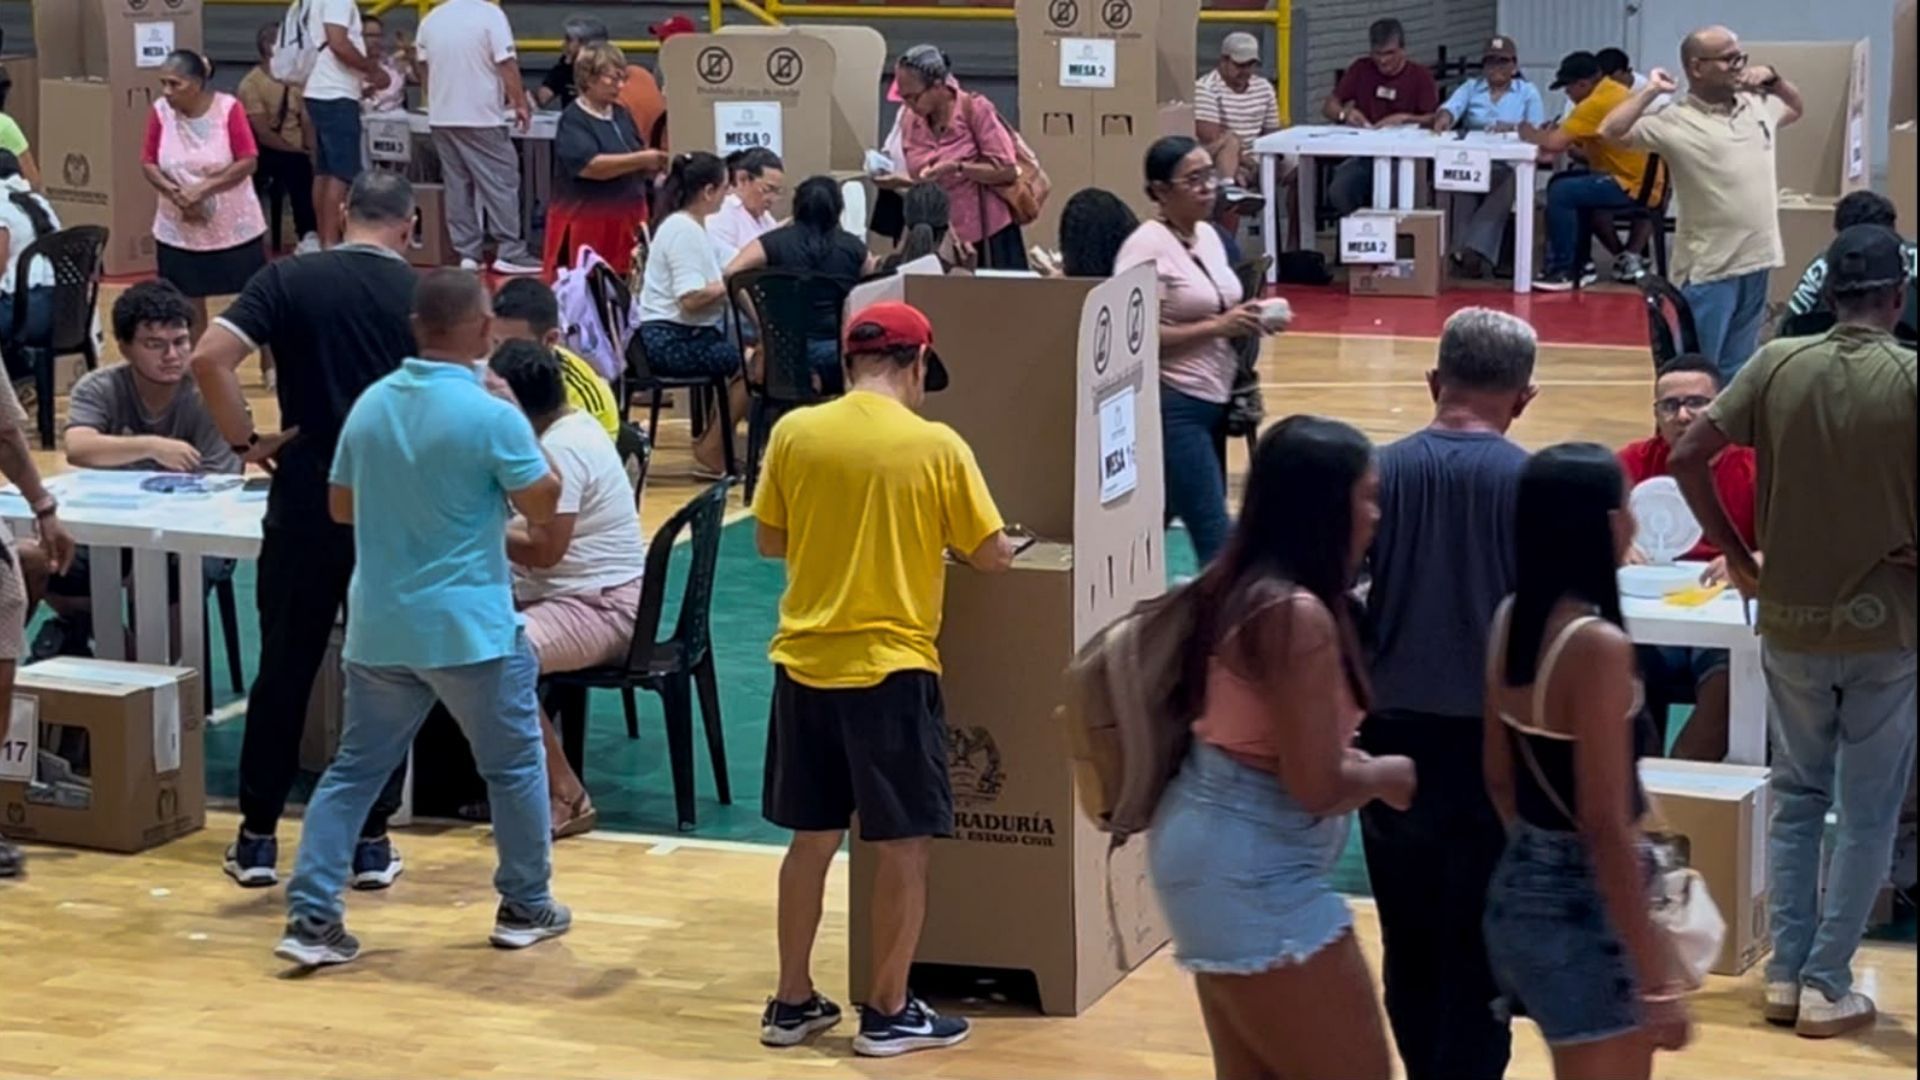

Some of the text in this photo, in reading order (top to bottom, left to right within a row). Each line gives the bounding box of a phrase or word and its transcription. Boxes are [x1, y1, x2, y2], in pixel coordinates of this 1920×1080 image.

[1068, 63, 1106, 77] MESA 2
[725, 132, 771, 146] MESA 9
[1442, 169, 1482, 182] MESA 2
[1347, 241, 1387, 253] MESA 2
[1105, 446, 1126, 479] MESA
[4, 740, 28, 762] 17
[954, 811, 1055, 835] RADURÍA
[968, 831, 1018, 844] ESTADO
[1021, 834, 1055, 847] CIVIL
